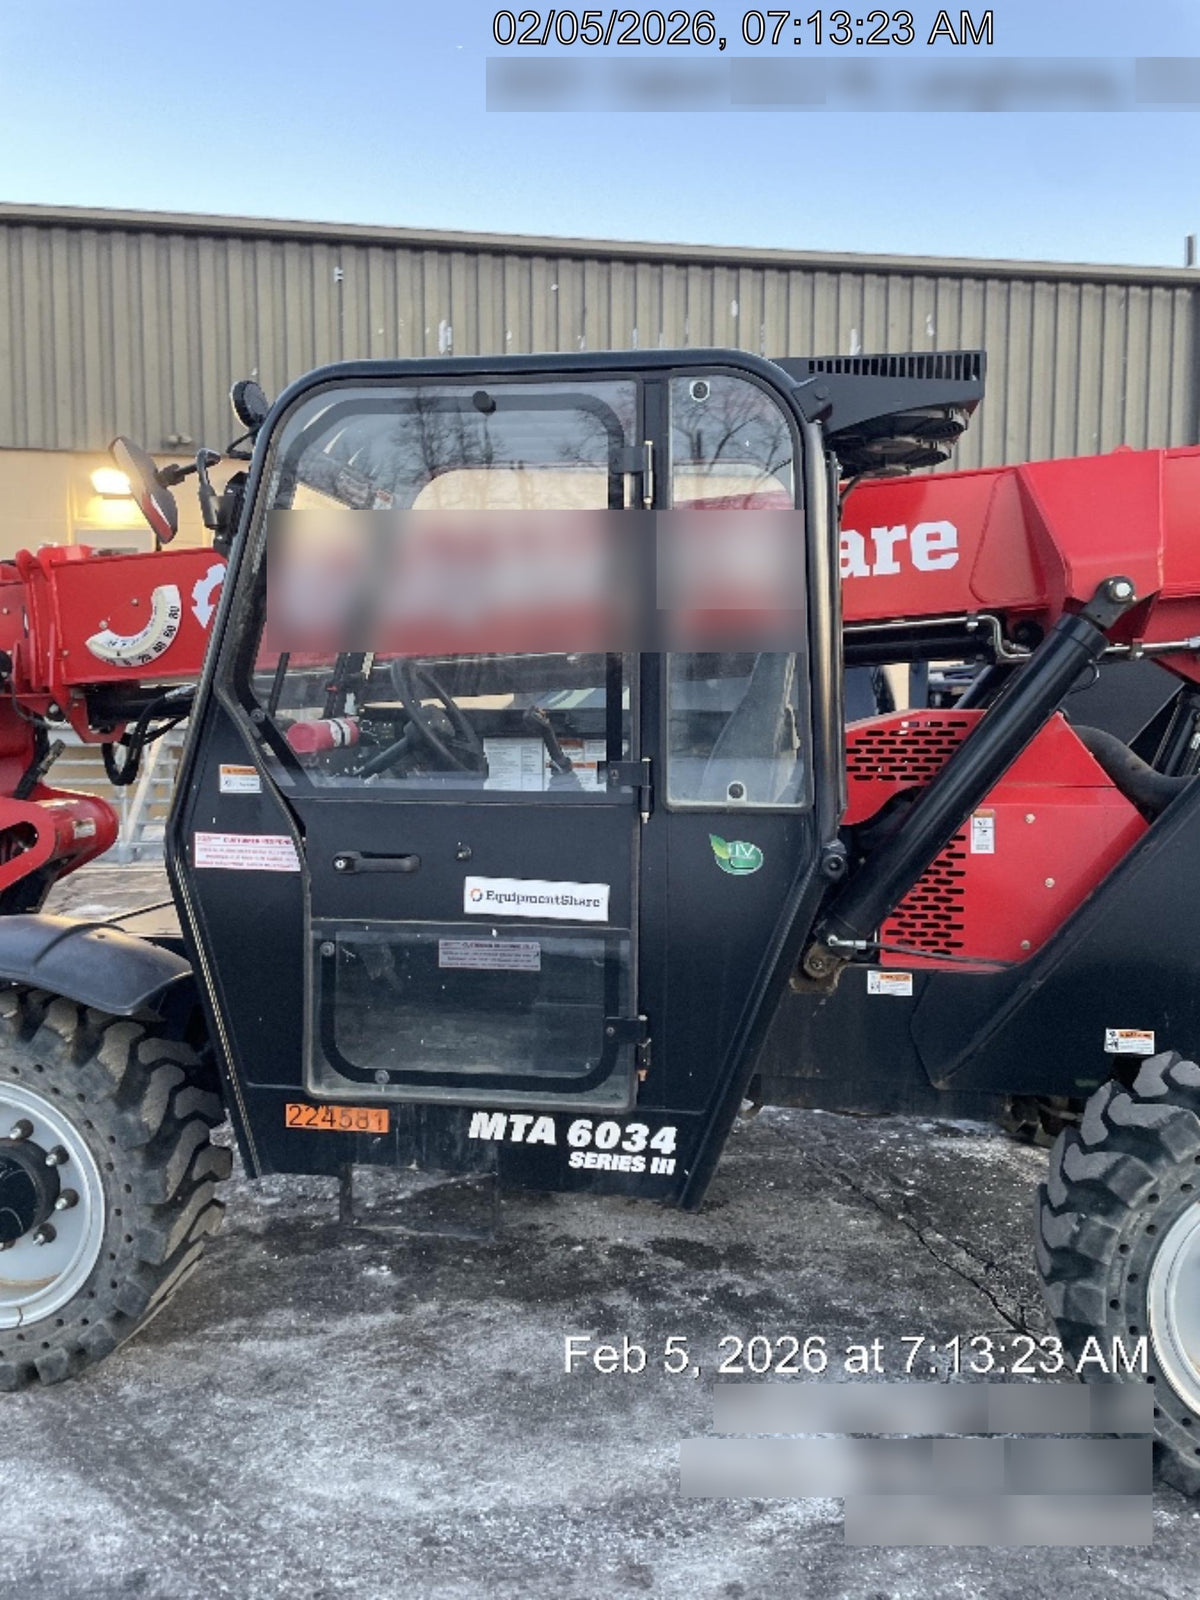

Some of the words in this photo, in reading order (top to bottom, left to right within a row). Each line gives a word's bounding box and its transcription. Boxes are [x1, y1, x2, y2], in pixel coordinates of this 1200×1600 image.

[485, 889, 601, 909] EquipmentShare
[288, 1104, 384, 1131] 224581
[468, 1111, 557, 1146] MTA
[567, 1119, 678, 1155] 6034
[568, 1151, 646, 1174] SERIES
[650, 1157, 677, 1176] III
